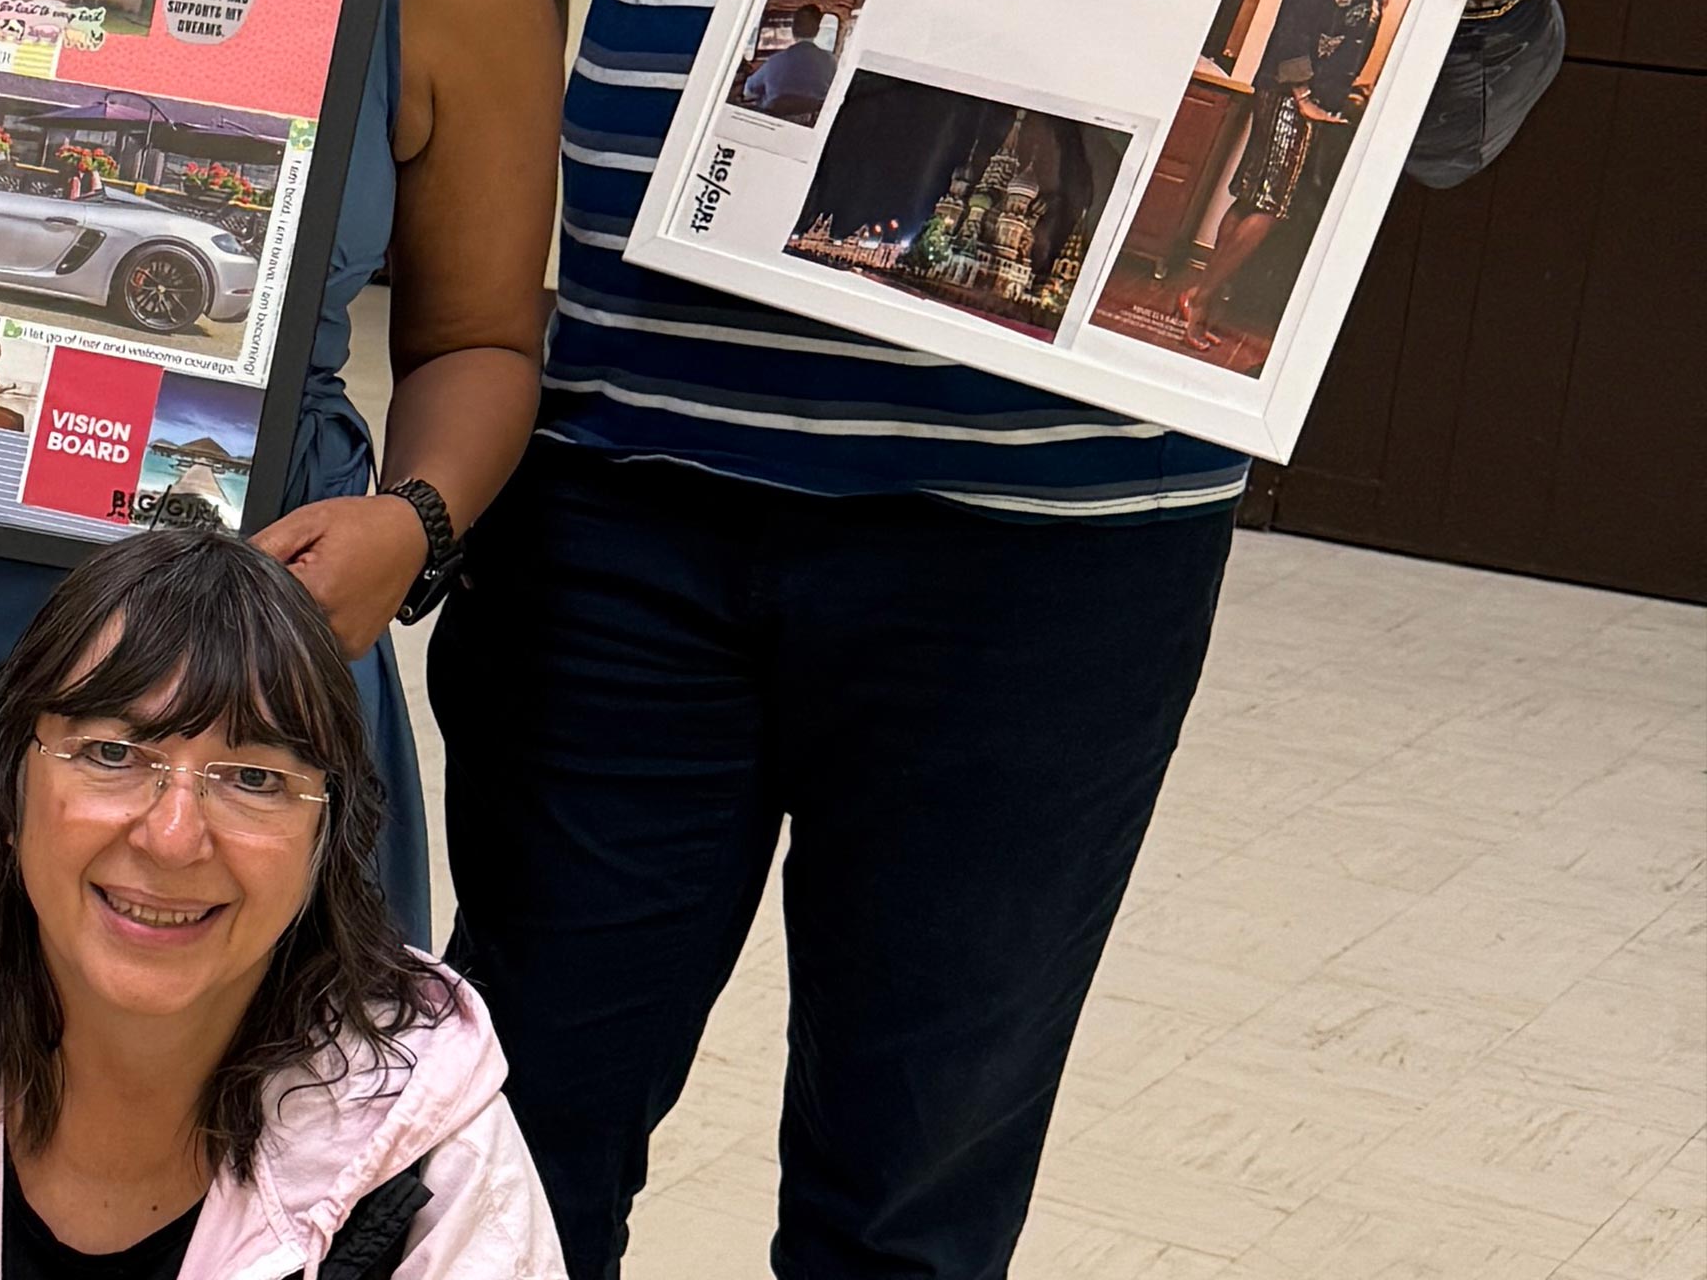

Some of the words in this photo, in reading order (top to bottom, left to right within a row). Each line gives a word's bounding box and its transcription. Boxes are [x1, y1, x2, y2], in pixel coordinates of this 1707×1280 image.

[167, 0, 222, 19] SUPPORTS
[225, 7, 243, 21] MY
[52, 408, 131, 443] VISION
[47, 431, 130, 465] BOARD
